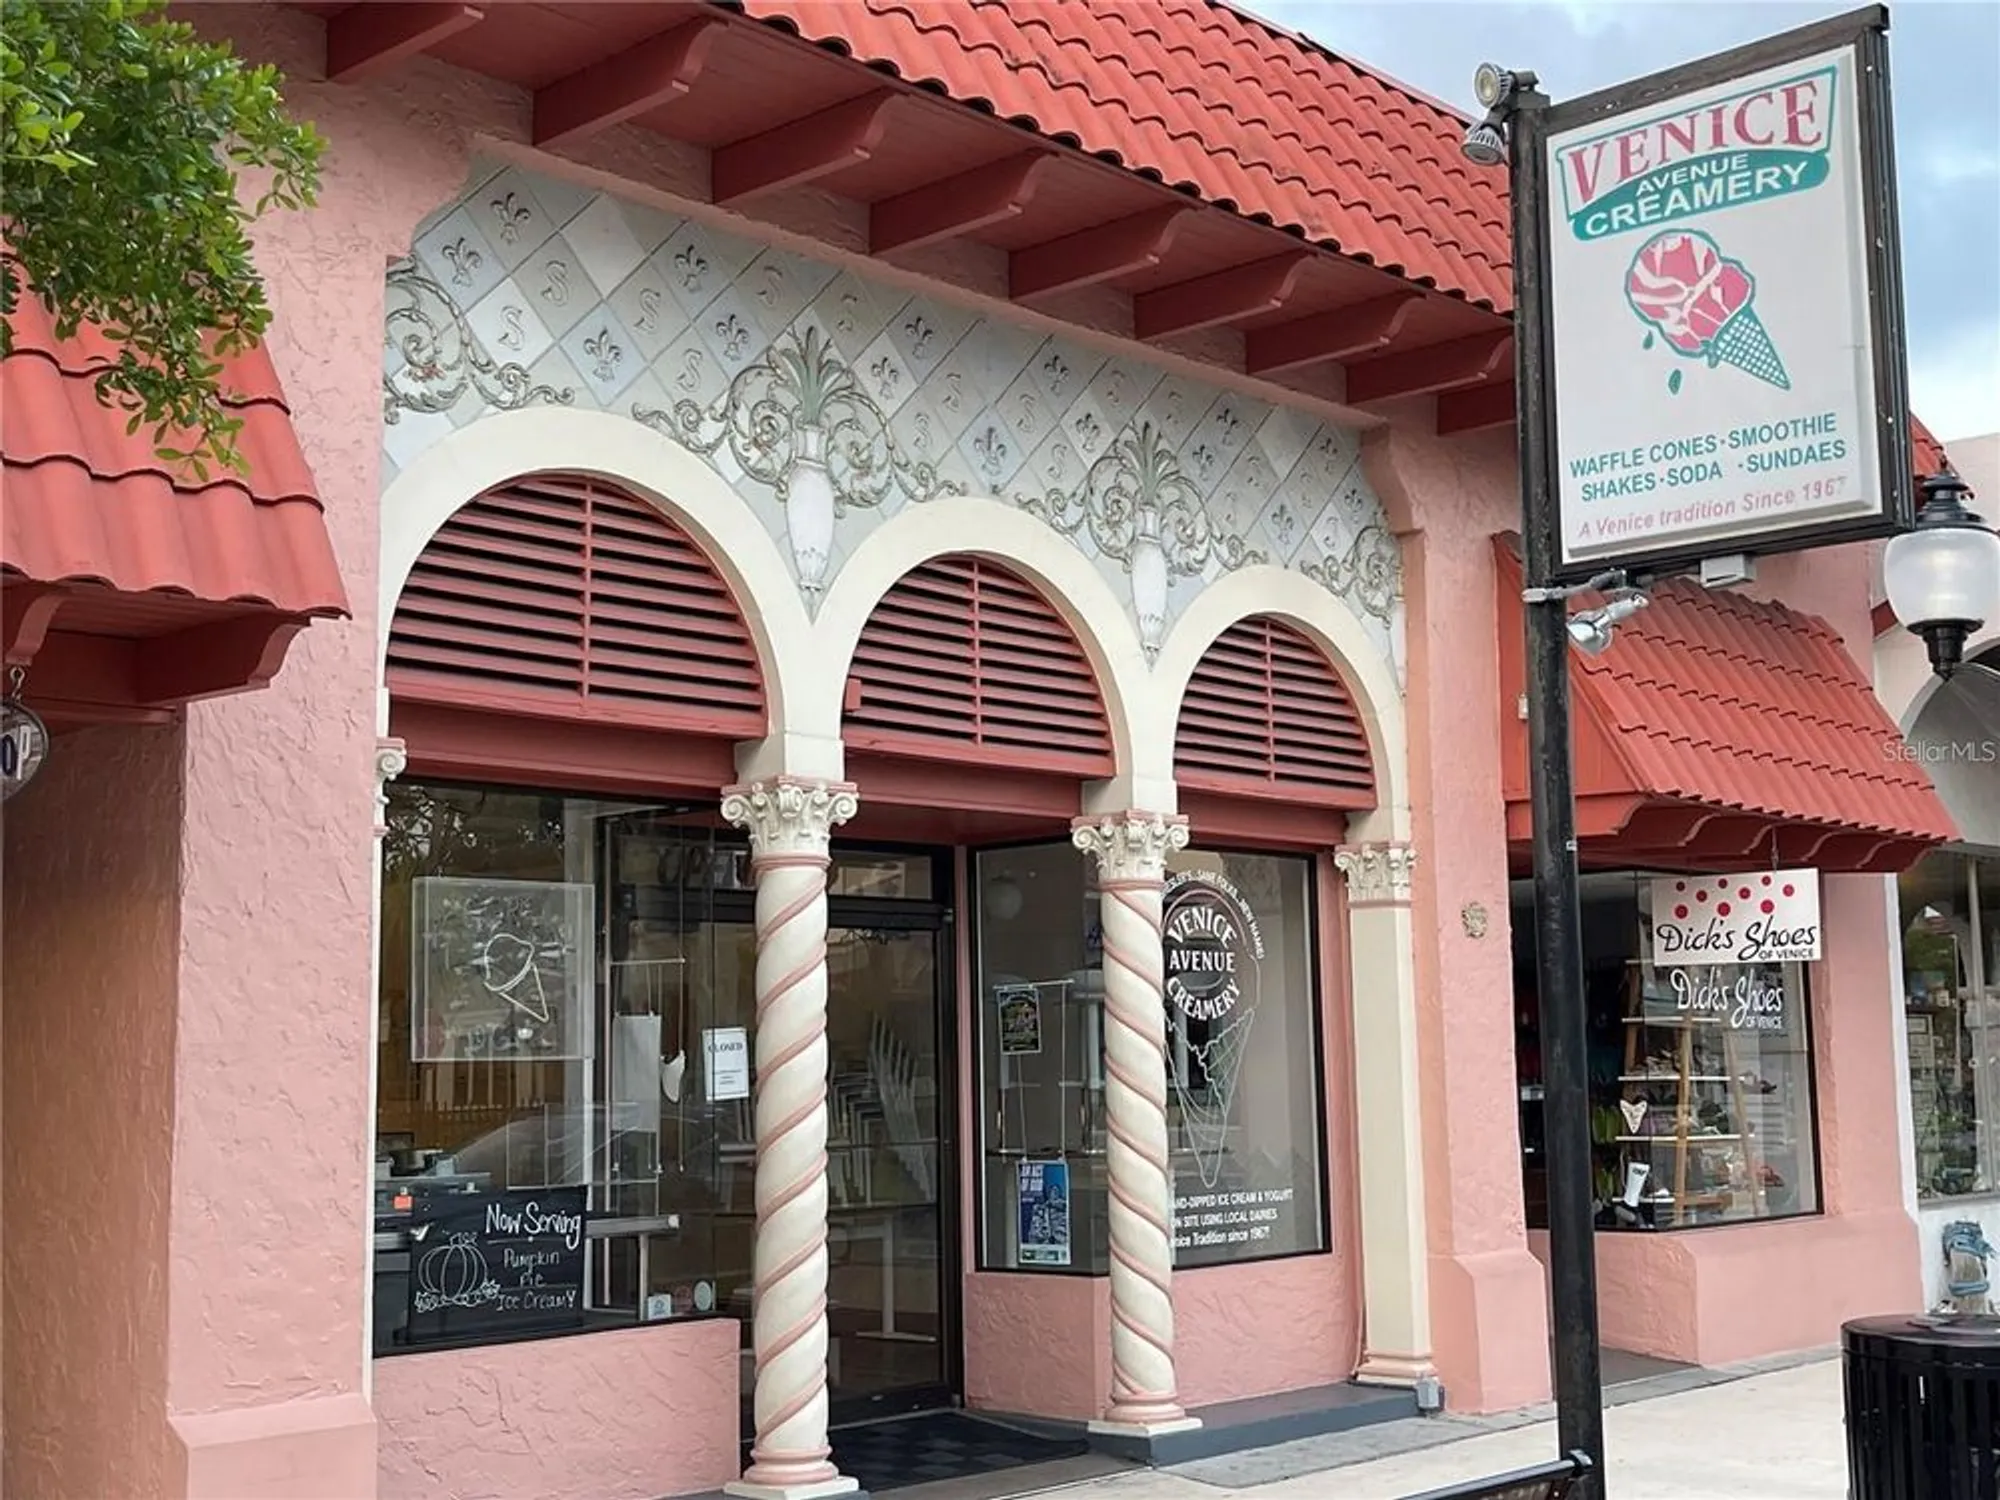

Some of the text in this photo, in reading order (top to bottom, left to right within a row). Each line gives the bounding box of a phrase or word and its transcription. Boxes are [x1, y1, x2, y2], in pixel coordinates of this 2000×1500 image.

[1568, 80, 1822, 204] VENICE
[1635, 153, 1749, 197] AVENUE
[1585, 160, 1808, 236] CREAMERY
[1569, 412, 1837, 479] WAFFLE CONES SMOOTHIE
[1581, 439, 1846, 502] SHAKES SODA SUNDAES
[1579, 476, 1848, 539] A Venice tradition Since 1967
[1167, 906, 1238, 949] VENICE
[1656, 915, 1818, 961] Dick's Shoes
[1169, 949, 1236, 973] AVENUE
[1758, 948, 1814, 960] OF VENICE
[1167, 976, 1240, 1021] CREAMERY
[1670, 965, 1784, 1029] Dick's Shoes
[708, 1042, 743, 1054] CLOSED
[485, 1201, 581, 1250] Now Serving
[1224, 1211, 1248, 1224] LOCAL
[504, 1248, 560, 1274] Pumpkin
[496, 1294, 521, 1311] Ice
